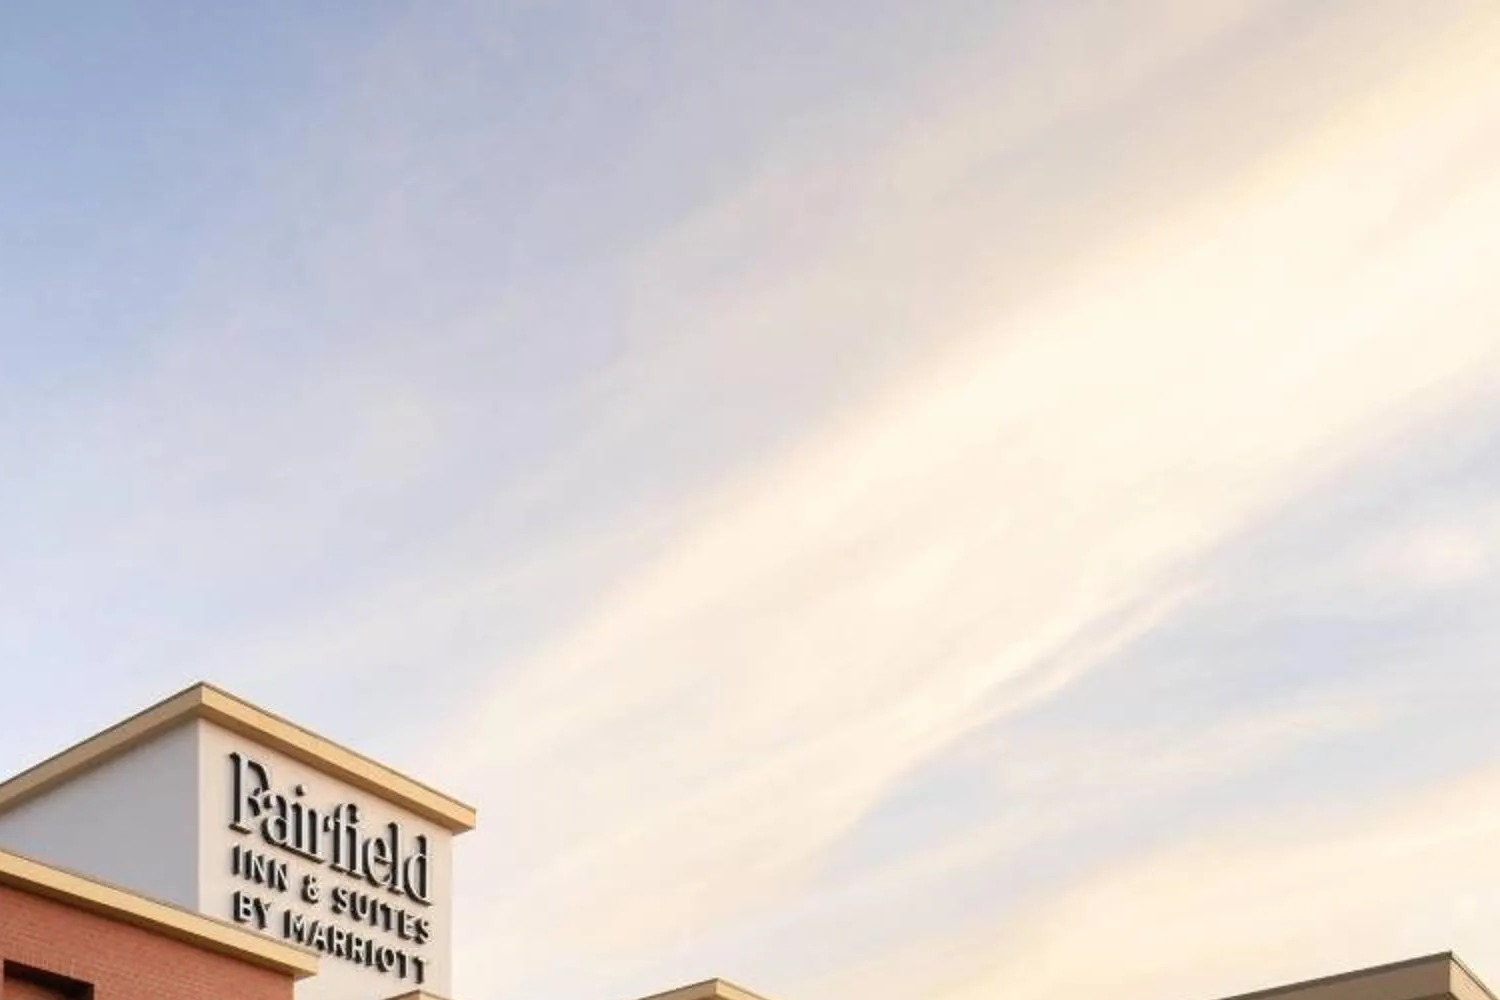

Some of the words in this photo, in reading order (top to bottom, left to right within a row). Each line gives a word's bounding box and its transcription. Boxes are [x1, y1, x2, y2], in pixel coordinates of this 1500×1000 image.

[229, 751, 432, 906] Fairfield
[231, 844, 290, 893] INN
[301, 873, 320, 904] &
[331, 885, 432, 945] SUITES
[232, 890, 271, 931] BY
[282, 908, 430, 985] MARRIOTT
